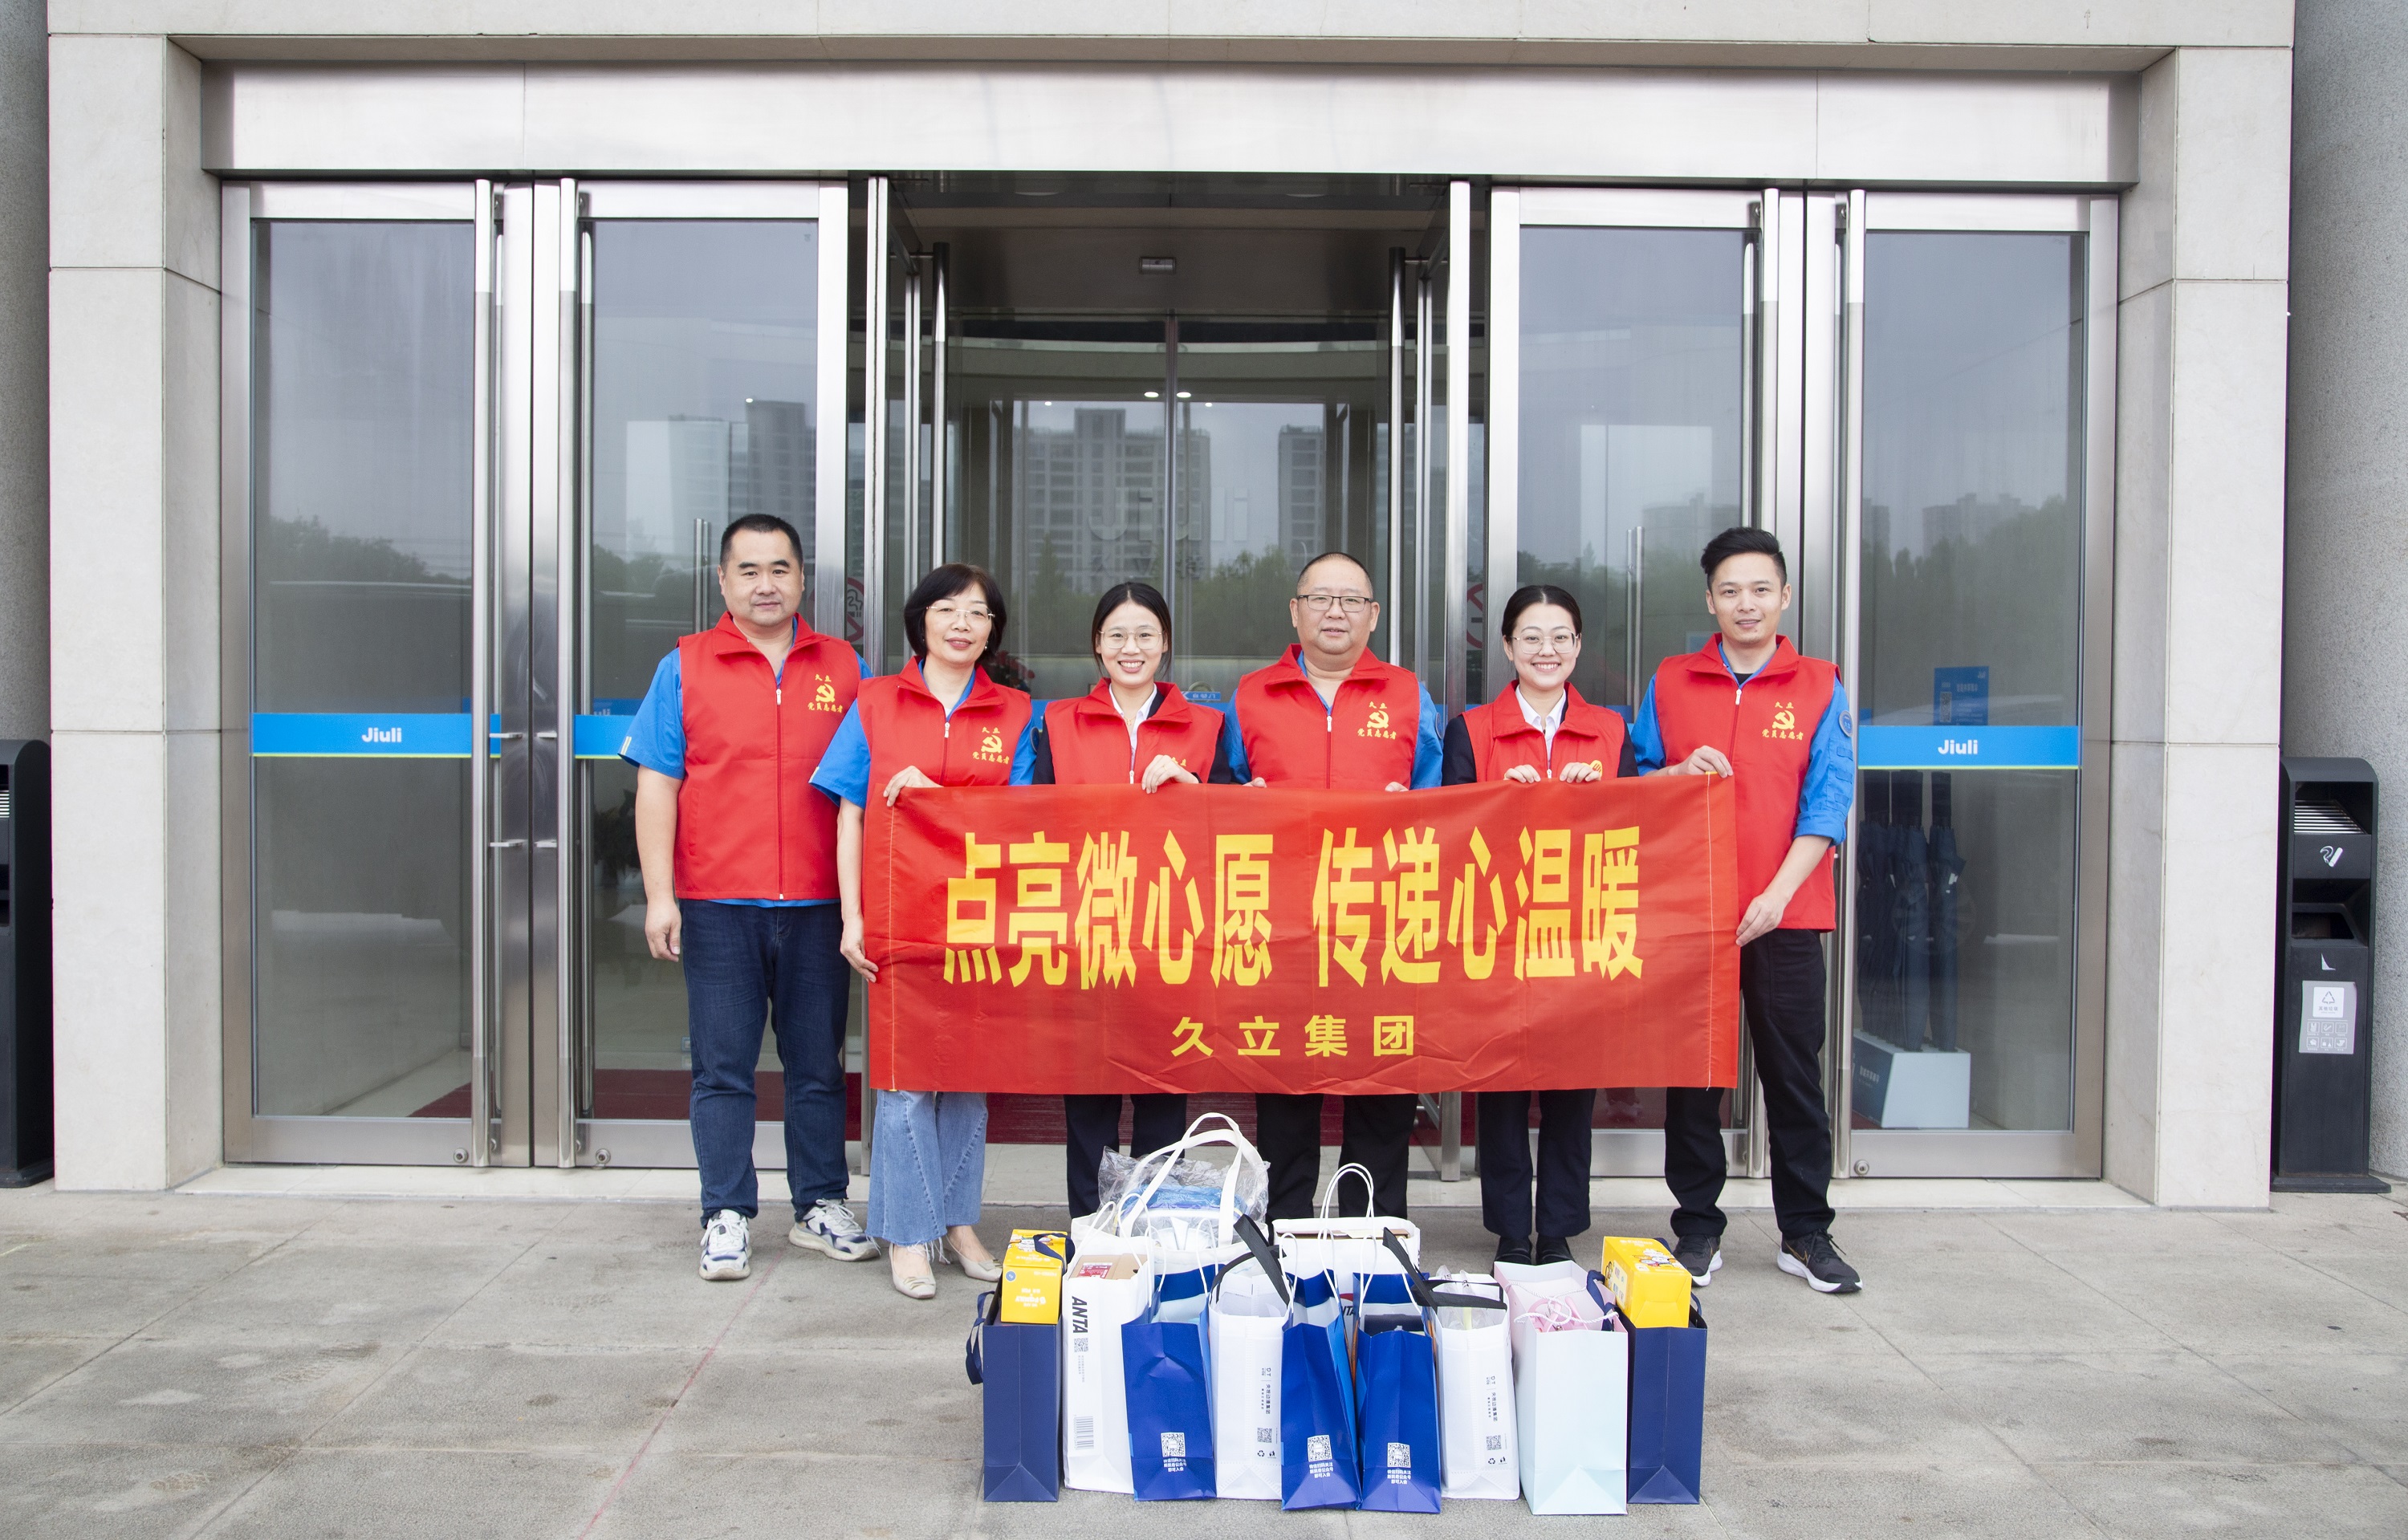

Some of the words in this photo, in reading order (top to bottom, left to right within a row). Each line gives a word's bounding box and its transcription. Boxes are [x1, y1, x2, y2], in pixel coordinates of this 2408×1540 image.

[361, 727, 402, 743] Jiuli
[1938, 739, 1979, 754] Jiuli
[942, 830, 1274, 990] 点亮微心愿
[1312, 826, 1644, 989] 传递心温暖
[1171, 1014, 1415, 1058] 久立集团
[1072, 1295, 1088, 1334] ANTA
